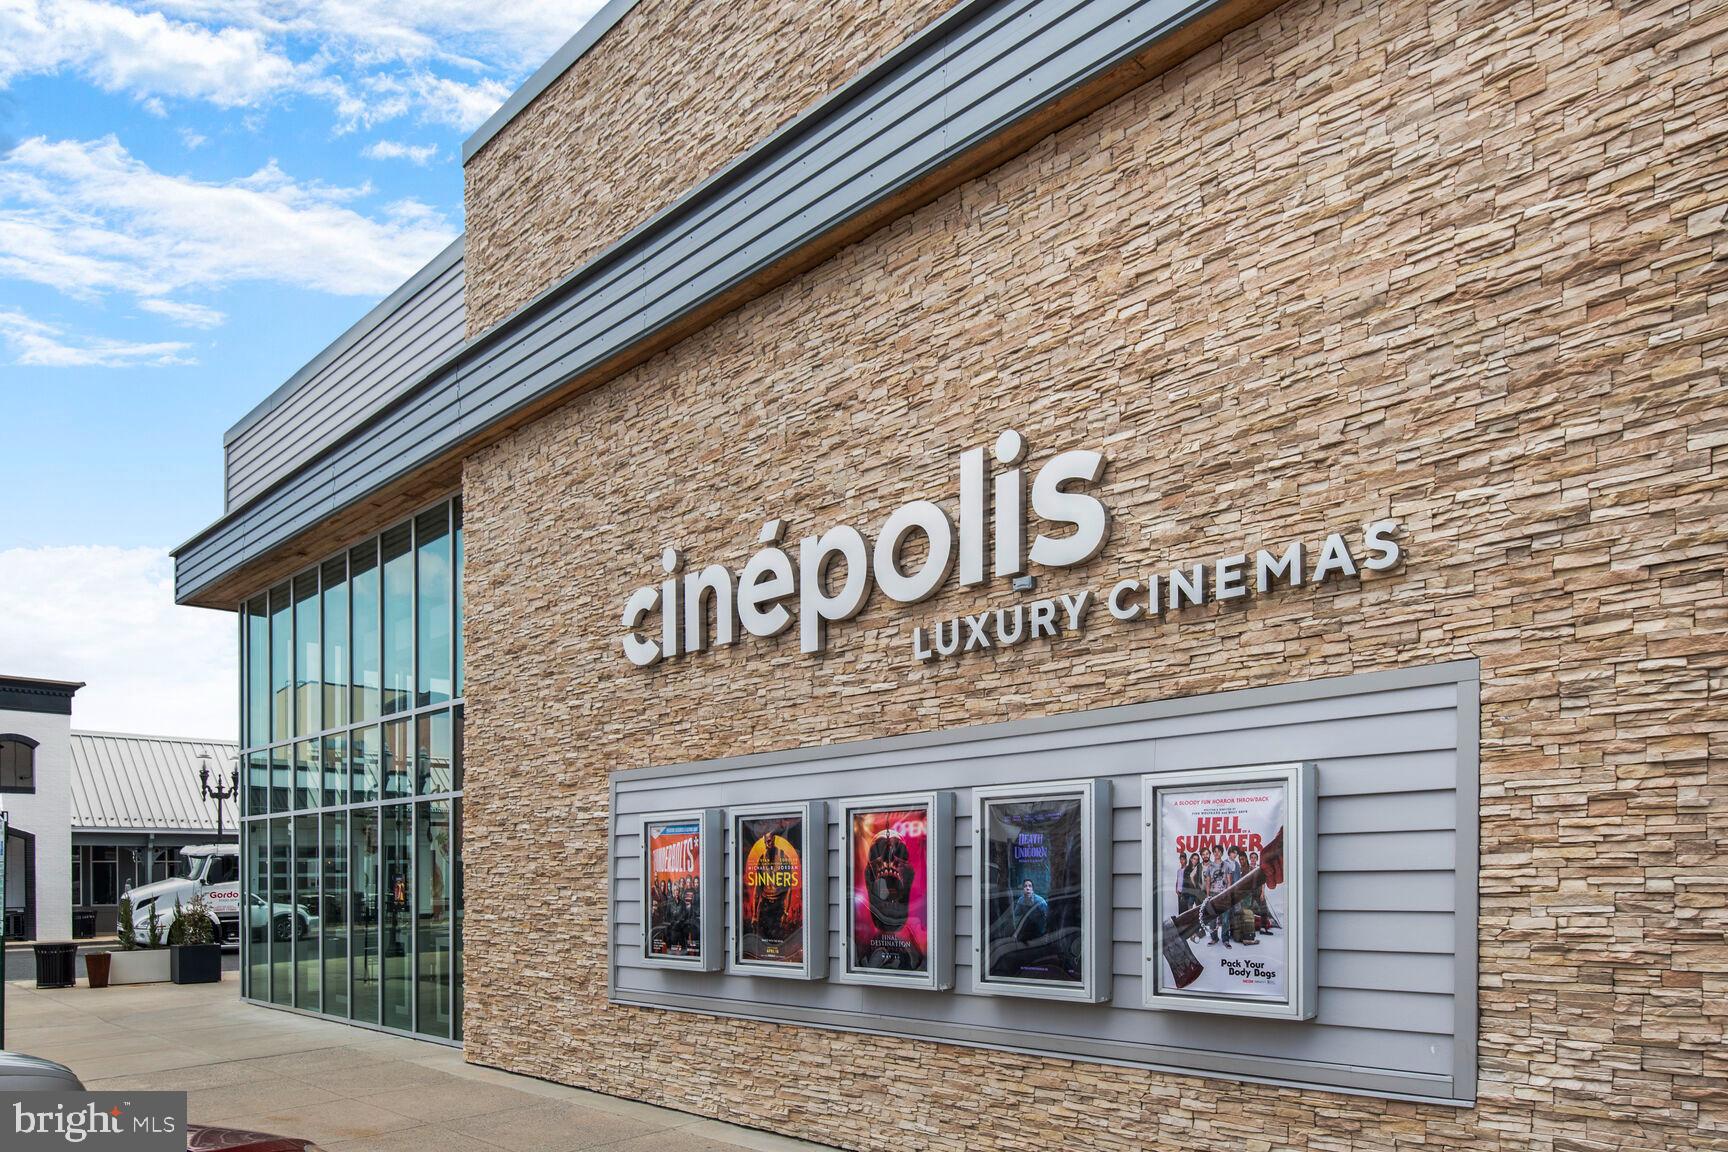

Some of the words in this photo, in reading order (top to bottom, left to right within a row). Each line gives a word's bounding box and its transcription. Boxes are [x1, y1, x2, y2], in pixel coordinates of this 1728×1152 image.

[622, 430, 1110, 667] cinépolis
[913, 591, 1091, 662] LUXURY
[1108, 521, 1401, 621] CINEMAS
[1196, 816, 1242, 834] HELL
[1176, 833, 1264, 854] SUMMER
[747, 871, 799, 887] SINNERS
[1220, 958, 1242, 968] Pack
[1244, 959, 1265, 969] Your
[1228, 967, 1251, 979] Body
[1254, 968, 1276, 980] Bags
